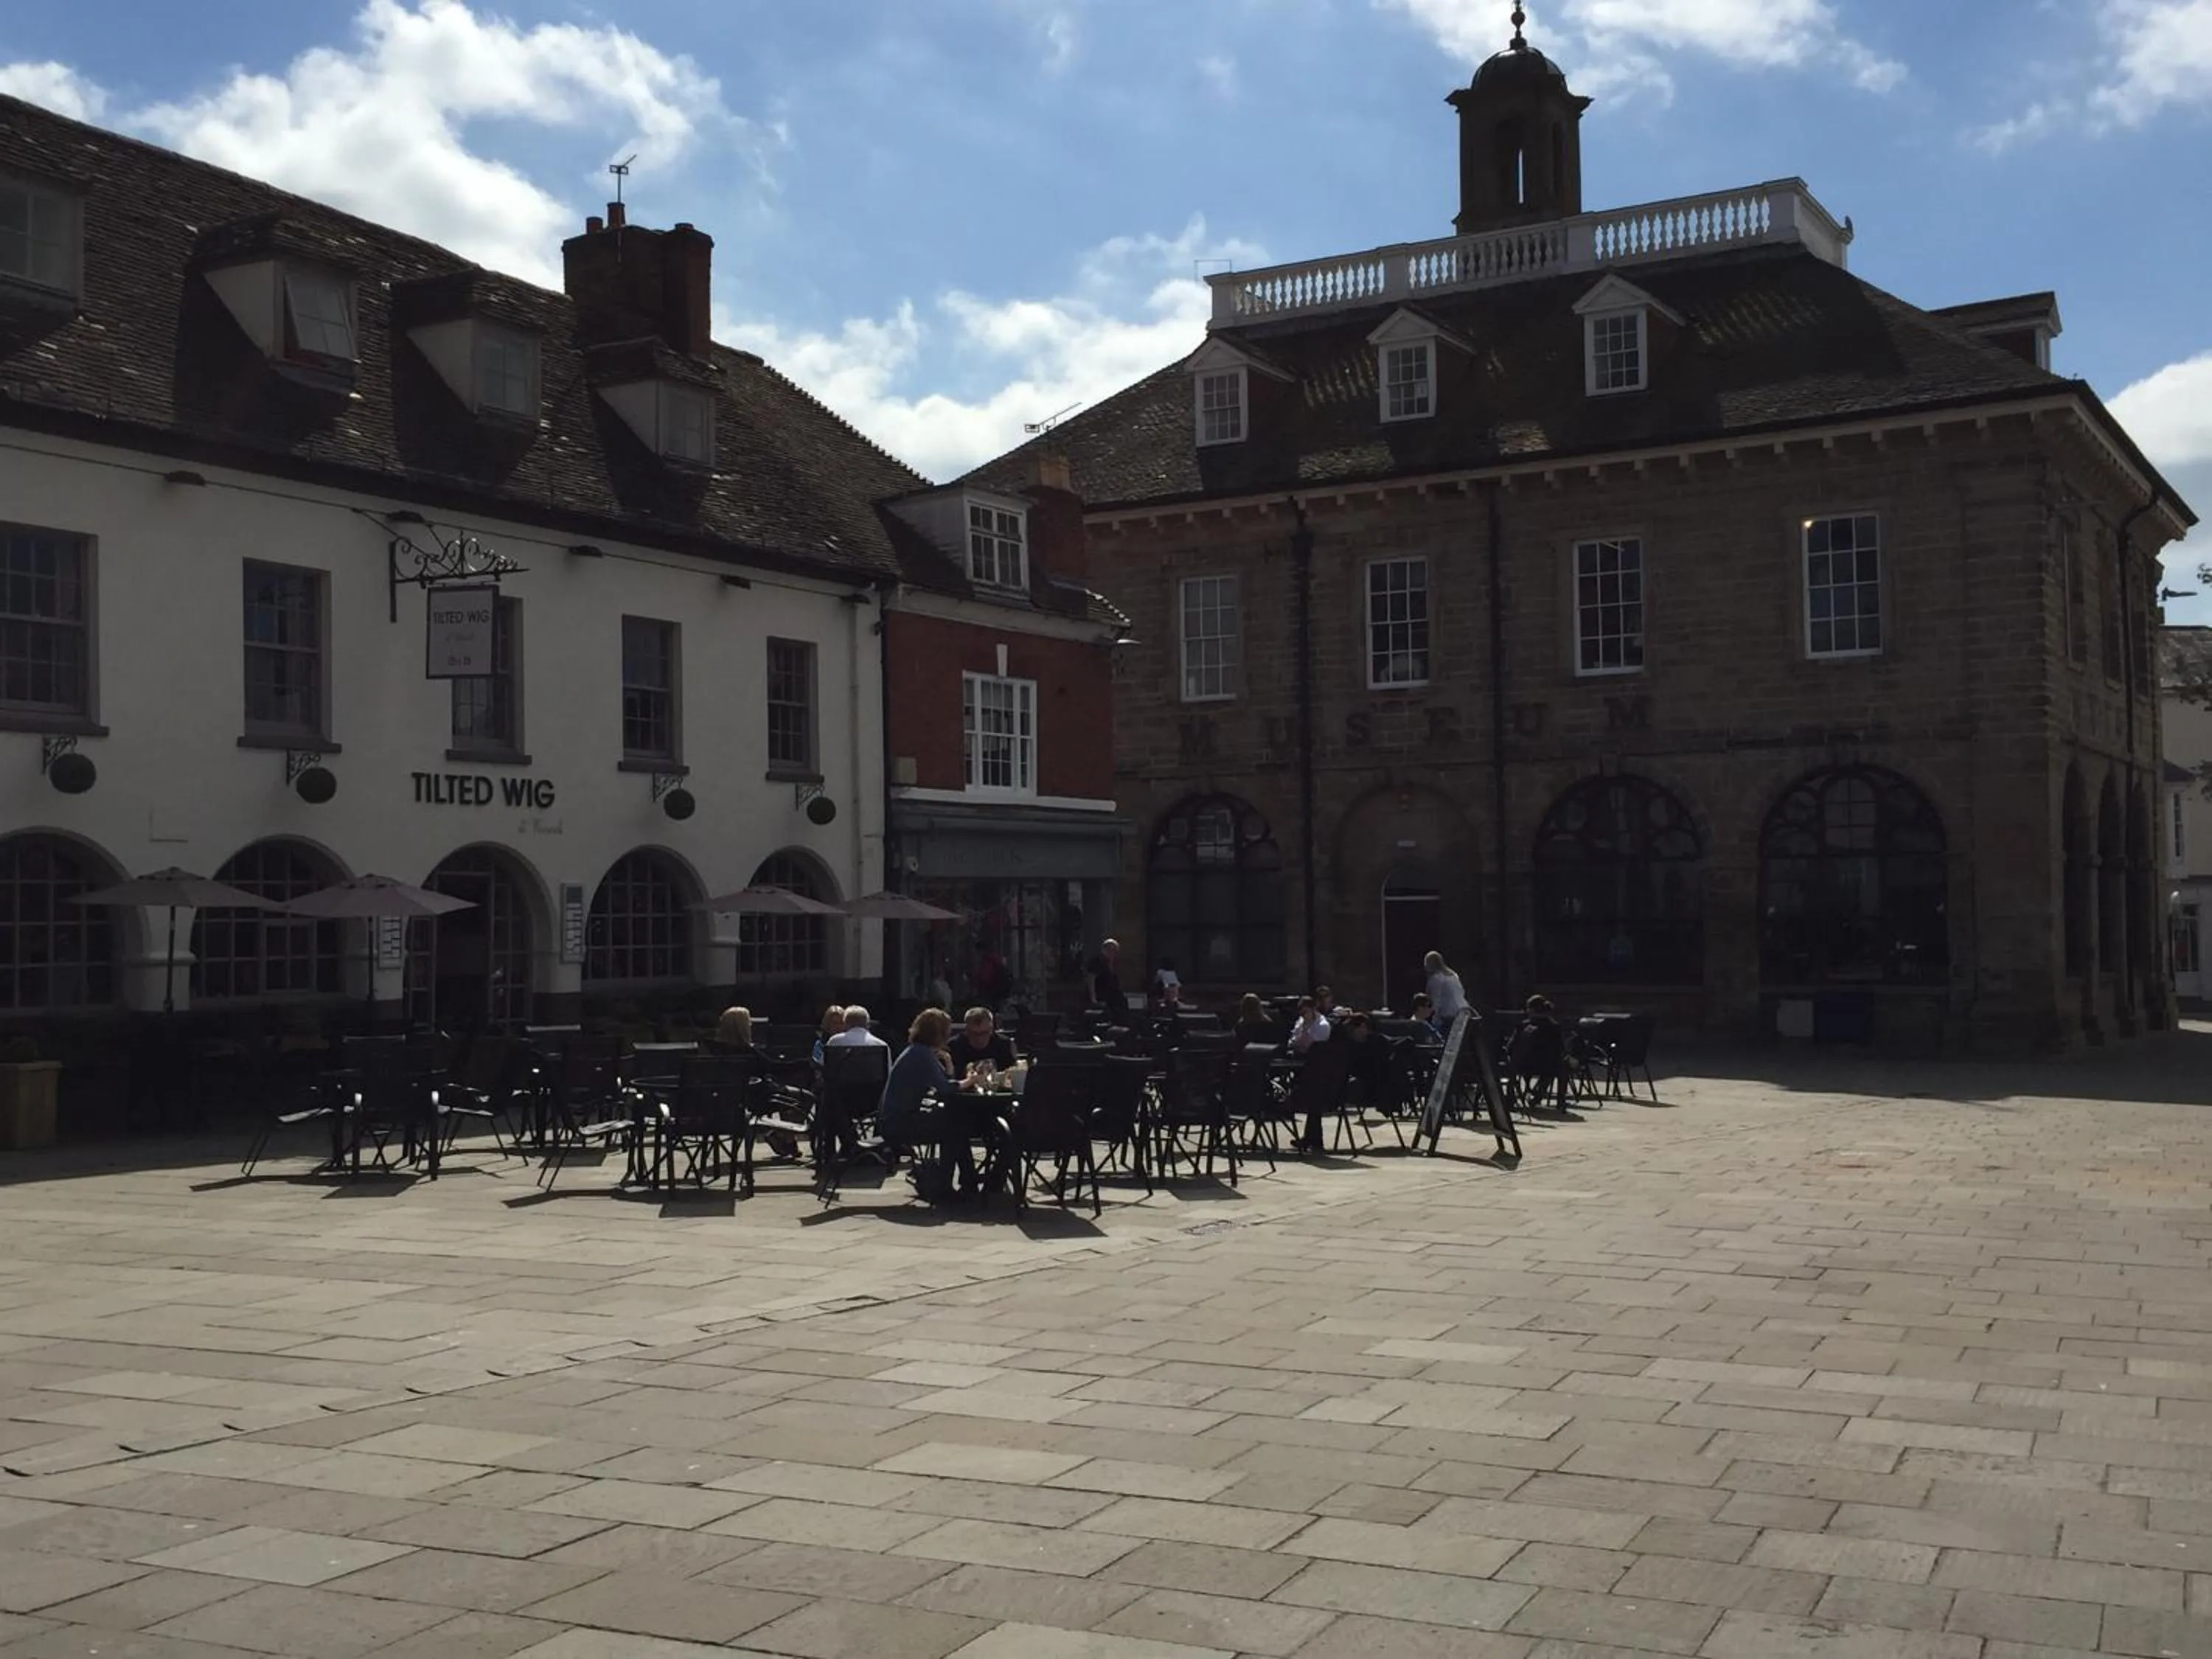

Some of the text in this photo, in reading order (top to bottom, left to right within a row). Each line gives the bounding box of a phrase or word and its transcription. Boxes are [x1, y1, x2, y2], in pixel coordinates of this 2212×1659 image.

[434, 610, 490, 625] TILTED WIG
[1178, 695, 1654, 758] MUSEUM
[411, 772, 555, 808] TILTED WIG
